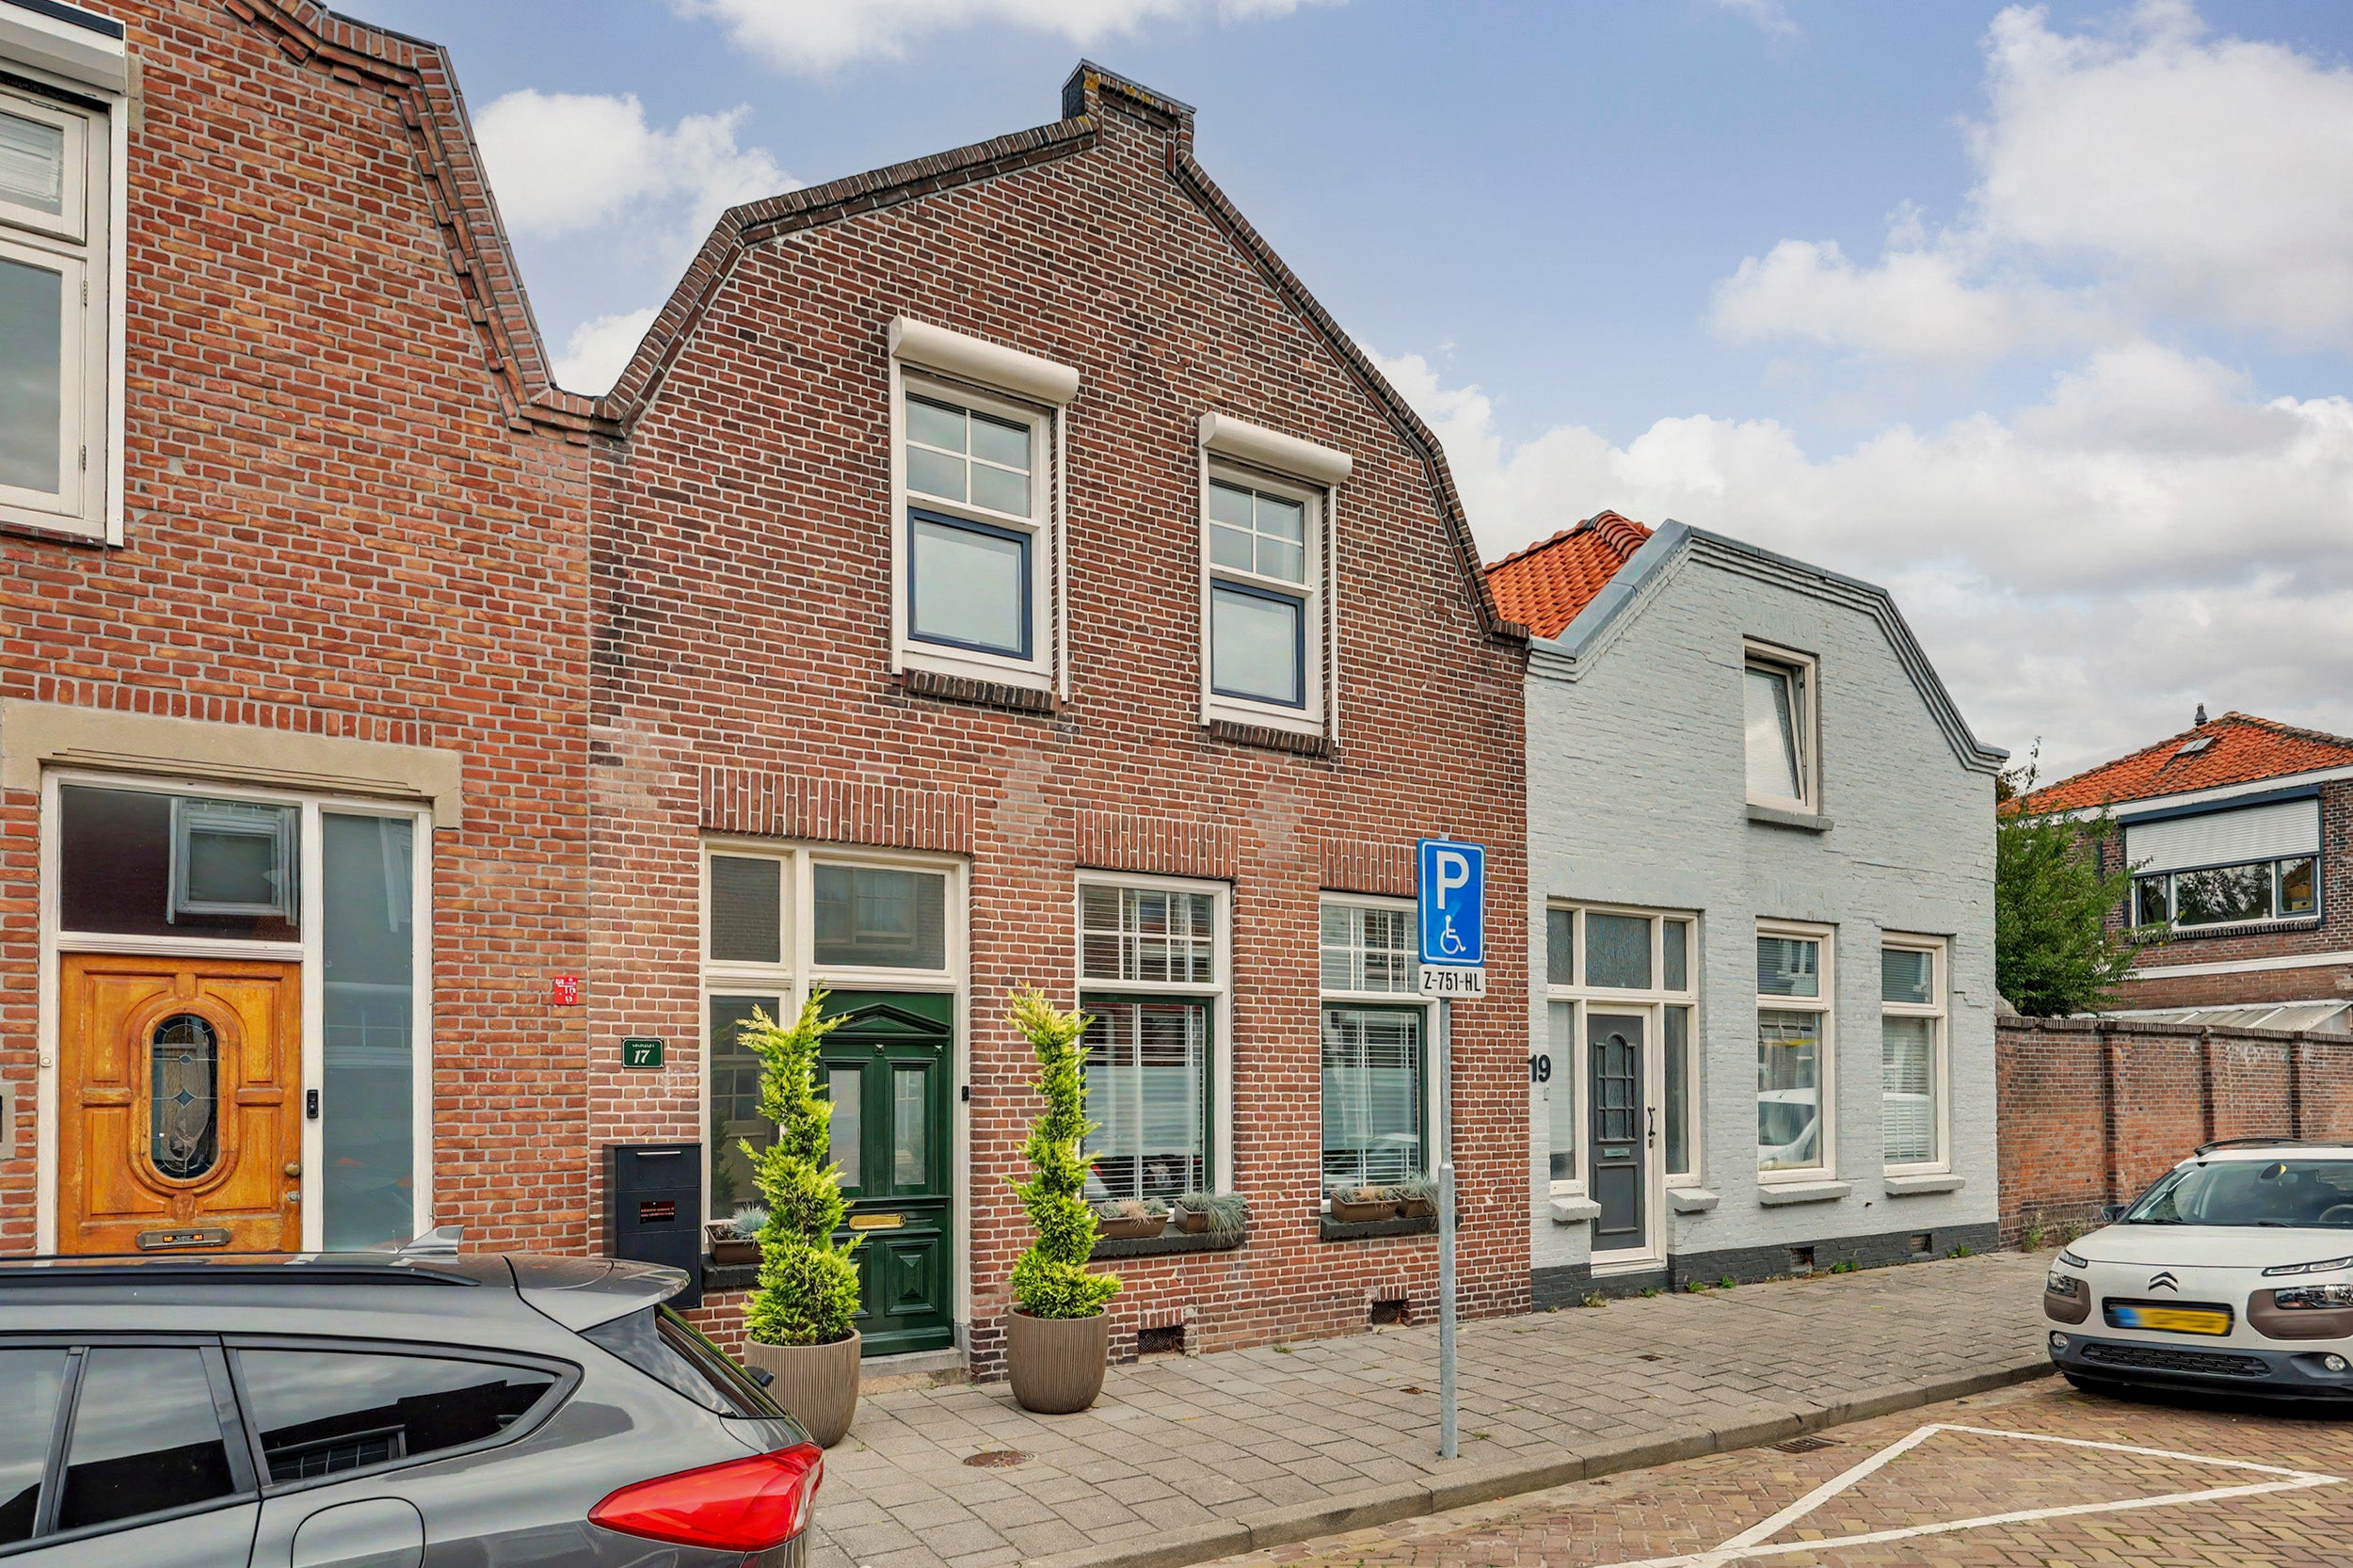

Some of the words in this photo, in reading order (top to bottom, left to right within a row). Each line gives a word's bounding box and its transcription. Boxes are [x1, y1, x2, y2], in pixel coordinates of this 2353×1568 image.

[1436, 850, 1469, 909] P
[1423, 970, 1481, 992] Z-751-HL
[633, 1049, 650, 1064] 17
[1529, 1054, 1551, 1082] 19
